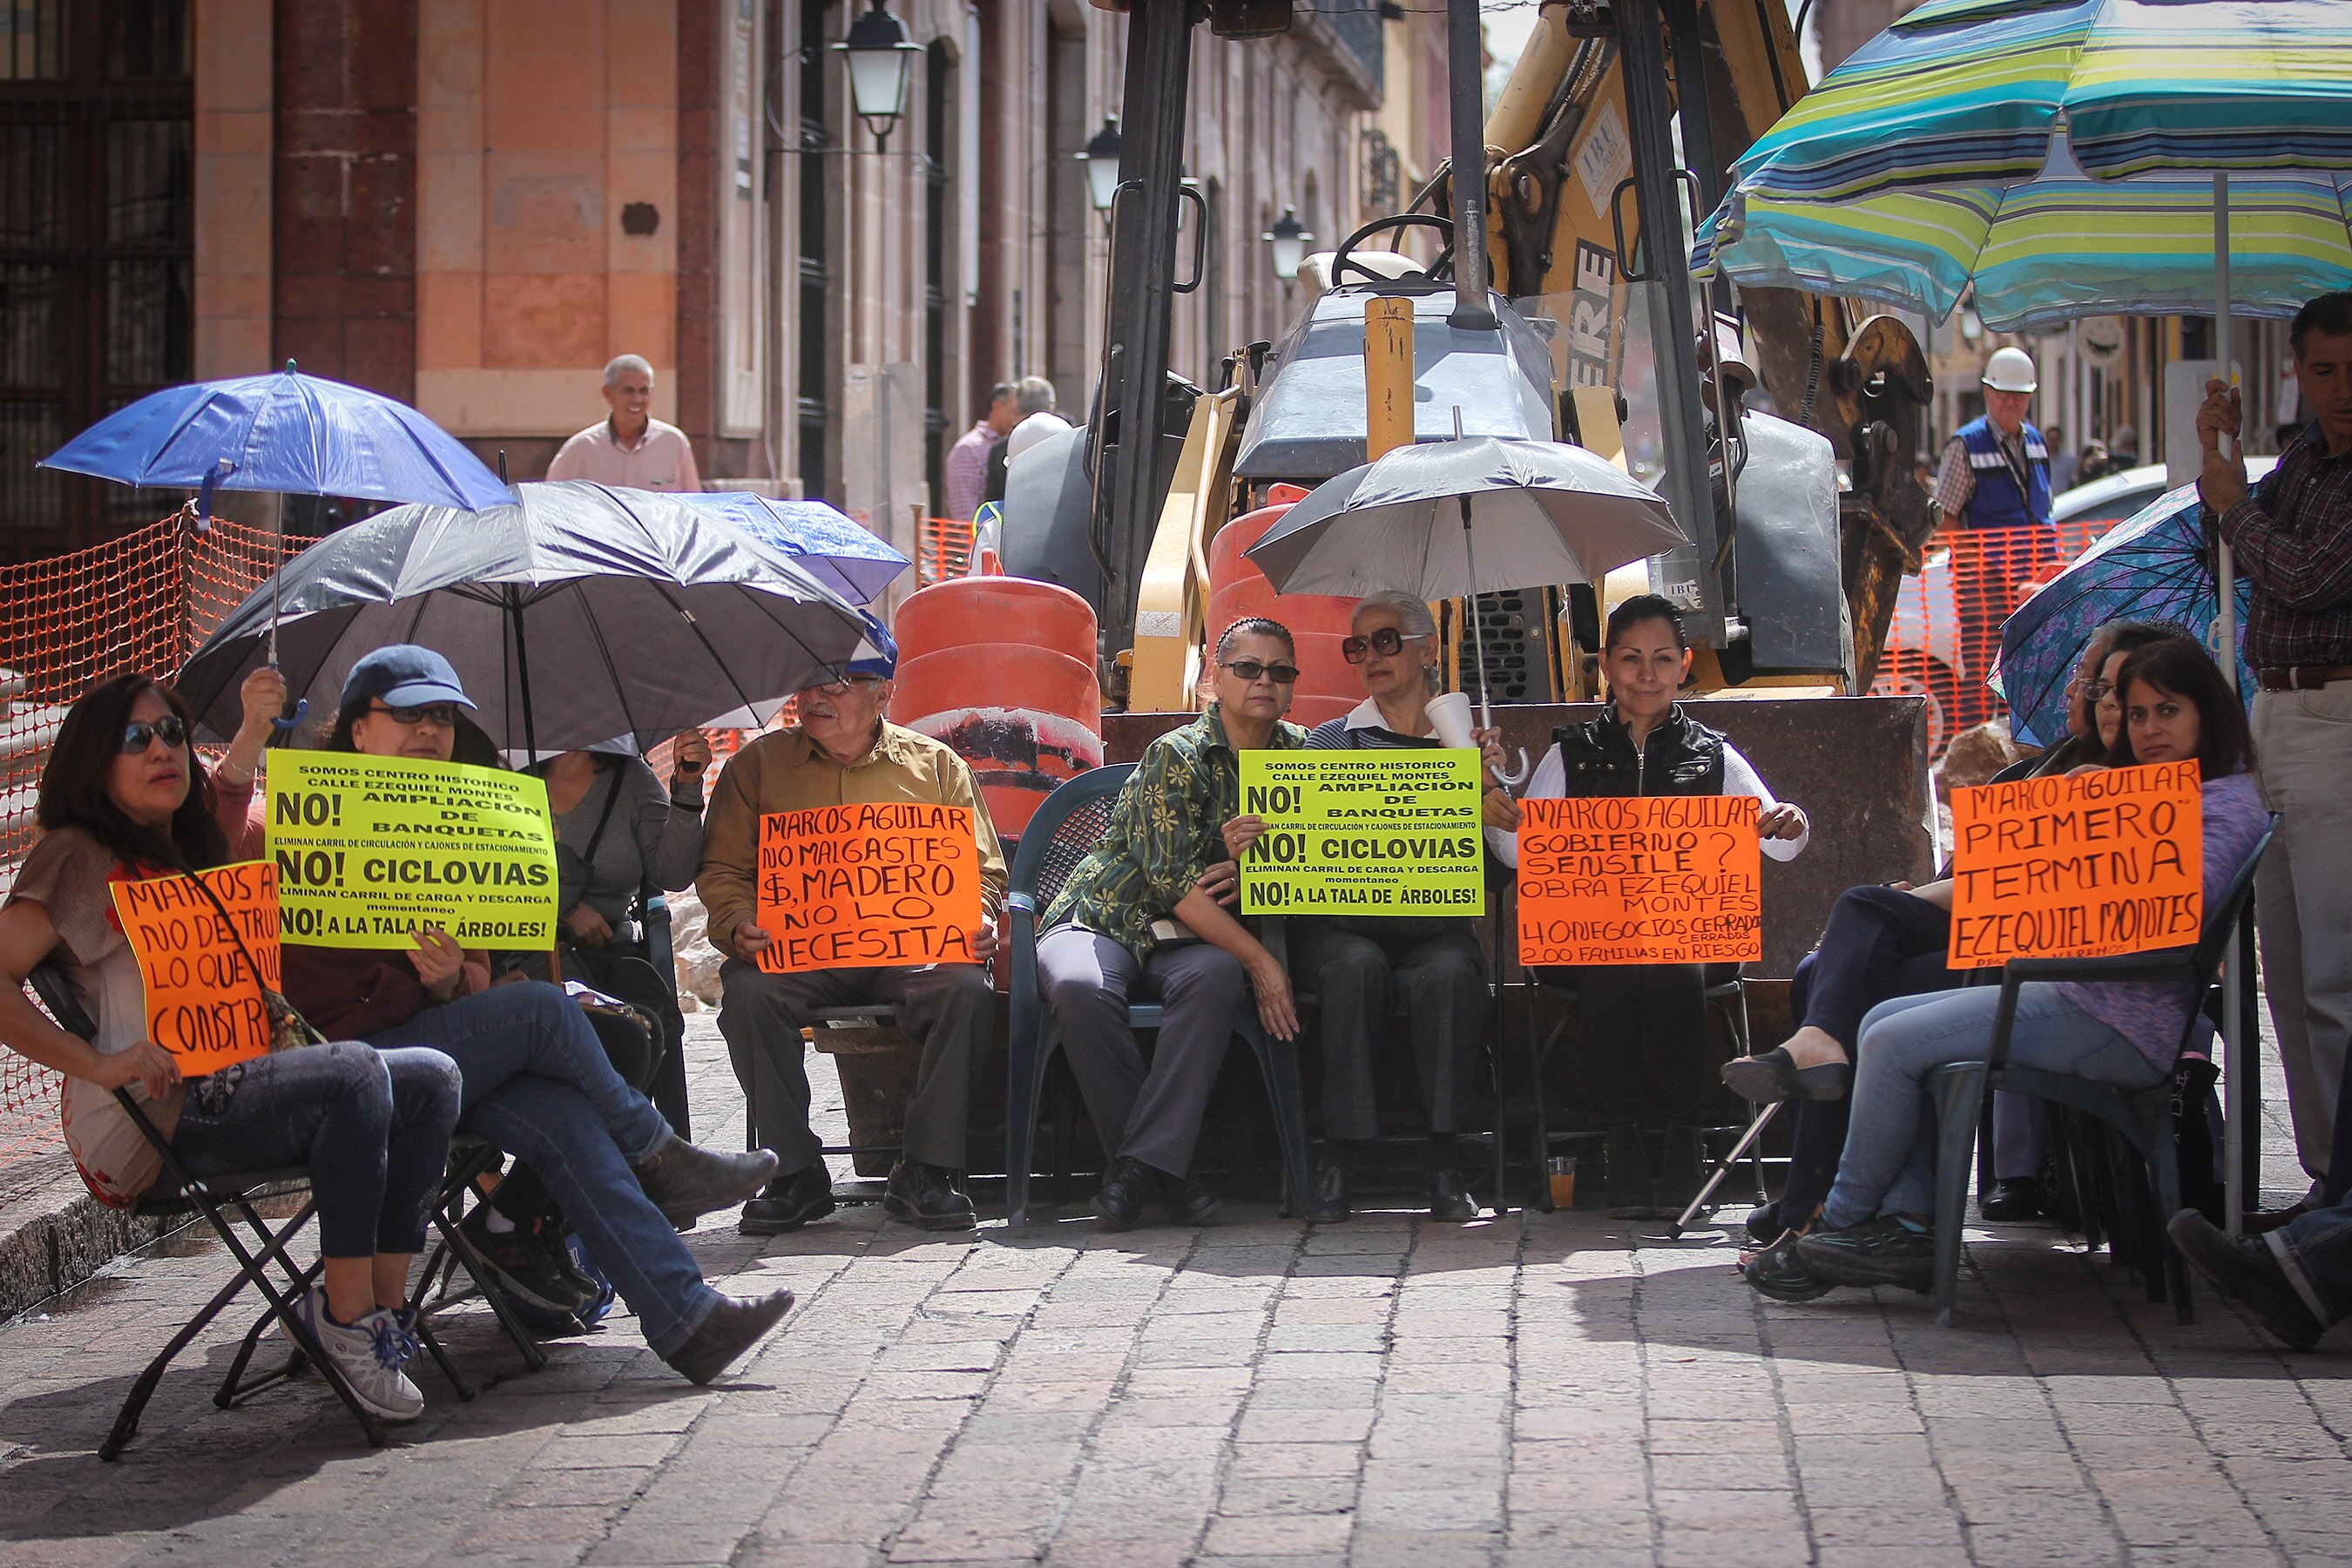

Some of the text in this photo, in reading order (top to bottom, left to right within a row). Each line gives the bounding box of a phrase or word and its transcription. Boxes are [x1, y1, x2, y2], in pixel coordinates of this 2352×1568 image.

[1671, 585, 1694, 595] IBU
[1320, 773, 1388, 781] EZEQUIEL
[1381, 761, 1456, 770] HISTORICO
[299, 766, 519, 792] SOMOS CENTRO HISTORICO
[308, 778, 513, 801] CALLE EZEQUIEL MONTES
[1318, 780, 1474, 792] AMPLIACIÓN
[1972, 761, 2201, 820] MARCO AGUILAR
[276, 792, 341, 827] NO!
[362, 792, 541, 818] AMPLIACIÓN
[1247, 786, 1301, 814] NO!
[1384, 795, 1416, 804] DE
[441, 811, 478, 821] DE
[767, 804, 971, 842] MARCOS AGUILAR
[1328, 808, 1474, 818] BANQUETAS
[1527, 797, 1761, 829] MARCOS AGUILAR
[372, 822, 544, 841] BANQUETAS
[1318, 821, 1363, 830] CIRCULACIÓN
[1414, 821, 1476, 830] ESTACIONAMIENTO
[274, 837, 314, 846] ELIMINAN
[316, 838, 346, 848] CARRIL
[348, 839, 358, 848] DE
[361, 839, 415, 849] CIRCULACIÓN
[425, 841, 460, 850] CAJONES
[463, 842, 474, 851] DE
[476, 843, 548, 855] ESTACIONAMIENTO
[1248, 833, 1476, 863] NO! CICLOVIAS
[1524, 831, 1698, 854] GOBIERNO
[276, 849, 549, 887] NO! CICLOVIAS
[763, 845, 794, 869] NO
[1527, 850, 1694, 877] SENSILE
[802, 863, 955, 903] MADERO
[1957, 840, 2185, 903] TERMINA
[280, 888, 336, 898] LIMINAN
[341, 890, 390, 900] CARRIL
[394, 892, 412, 901] DE
[479, 895, 551, 904] DESCARGA
[1250, 882, 1476, 906] NO! A LA TALA DE ÁRBOLES!
[1520, 874, 1758, 898] OBRA EZEQUIEL
[367, 904, 456, 915] momentaneo
[785, 896, 935, 930] NO LO
[1624, 896, 1758, 913] MONTES
[279, 907, 323, 936] NO!
[328, 916, 340, 933] A
[346, 917, 368, 934] LA
[373, 917, 416, 934] TALA
[456, 916, 546, 937] ÁRBOLES!
[1956, 892, 2198, 959] EZEQUIEL MONTES
[139, 919, 188, 953] NO
[1678, 931, 1750, 944] CERRADOS
[1522, 942, 1760, 963] 200 FAMILIAS EN RIESGO
[151, 956, 189, 990] LO
[198, 950, 247, 990] QUE
